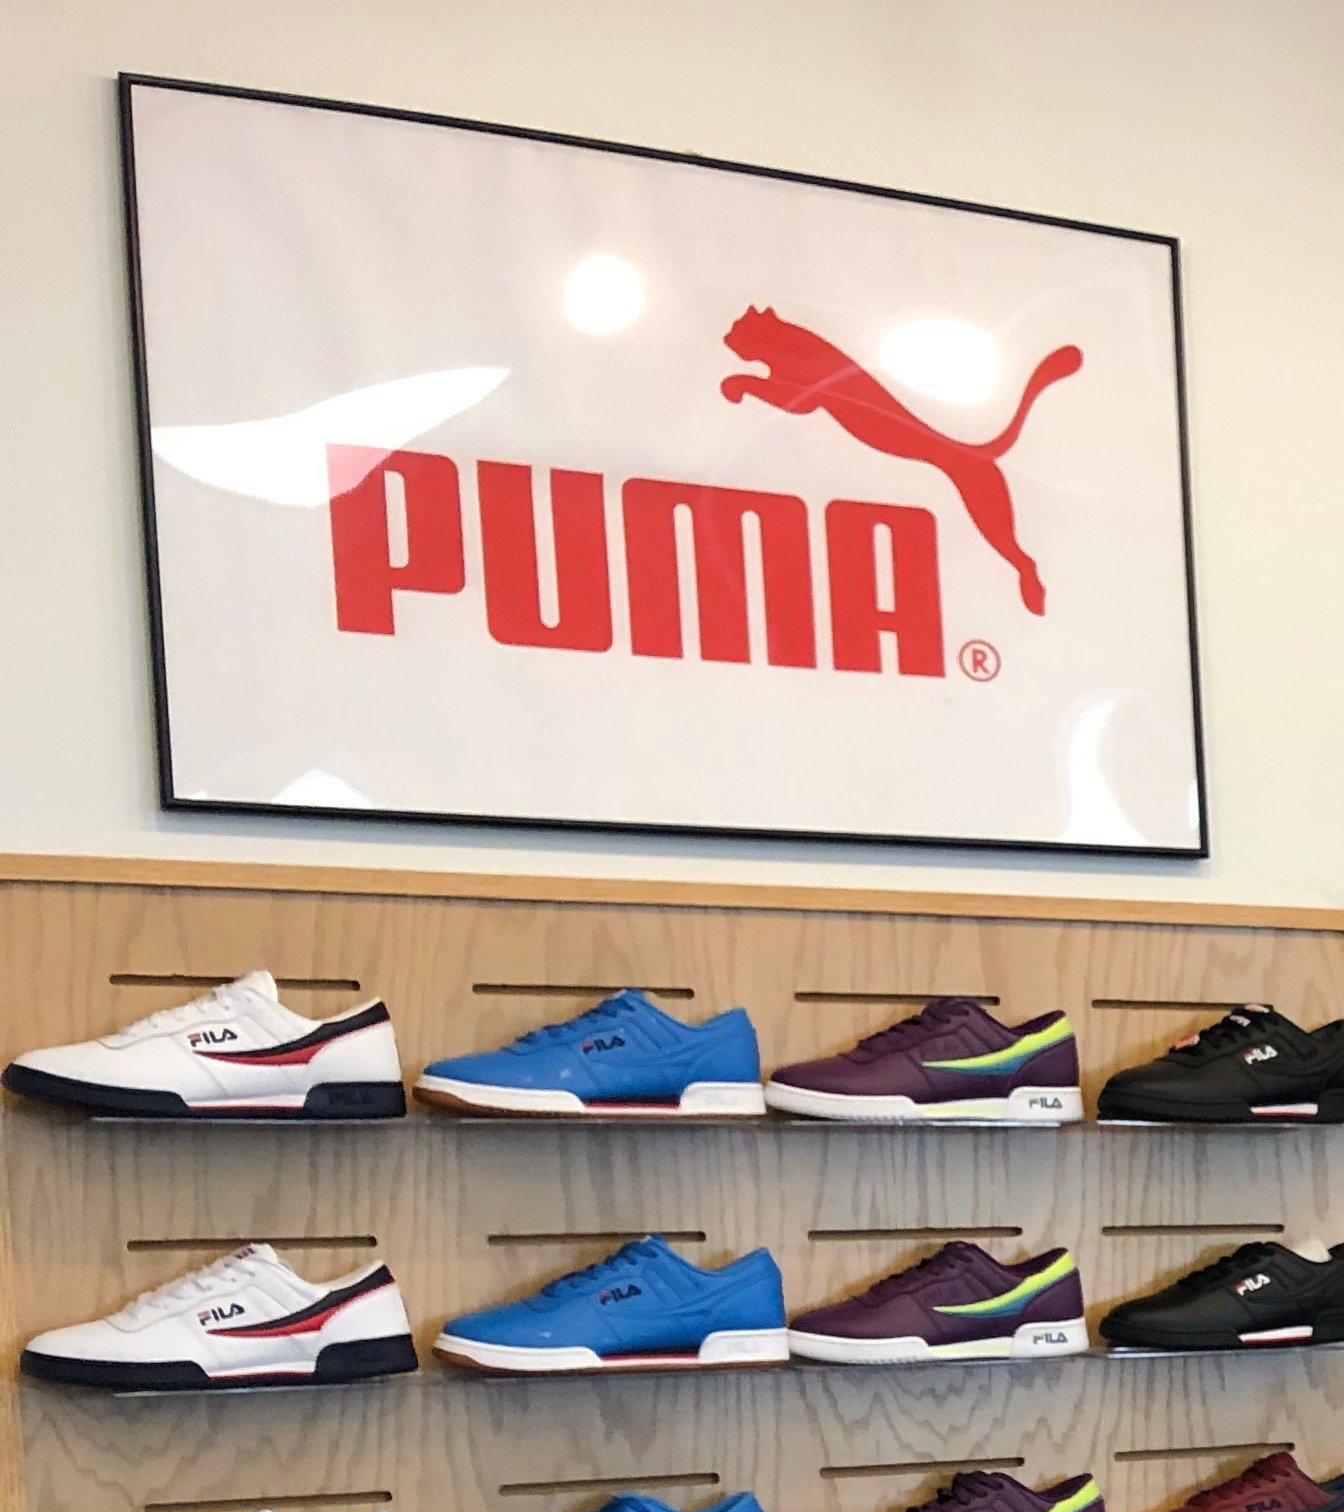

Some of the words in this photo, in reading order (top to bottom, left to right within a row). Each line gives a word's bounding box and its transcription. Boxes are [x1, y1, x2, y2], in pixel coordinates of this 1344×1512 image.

[325, 442, 946, 679] PUMA
[189, 1027, 240, 1048] FILA
[582, 1036, 625, 1053] FILA
[1028, 1096, 1064, 1110] FILA
[600, 1284, 641, 1304] FILA
[1236, 1273, 1271, 1296] FILA
[197, 1303, 245, 1326] FILA
[1033, 1331, 1068, 1345] FILA
